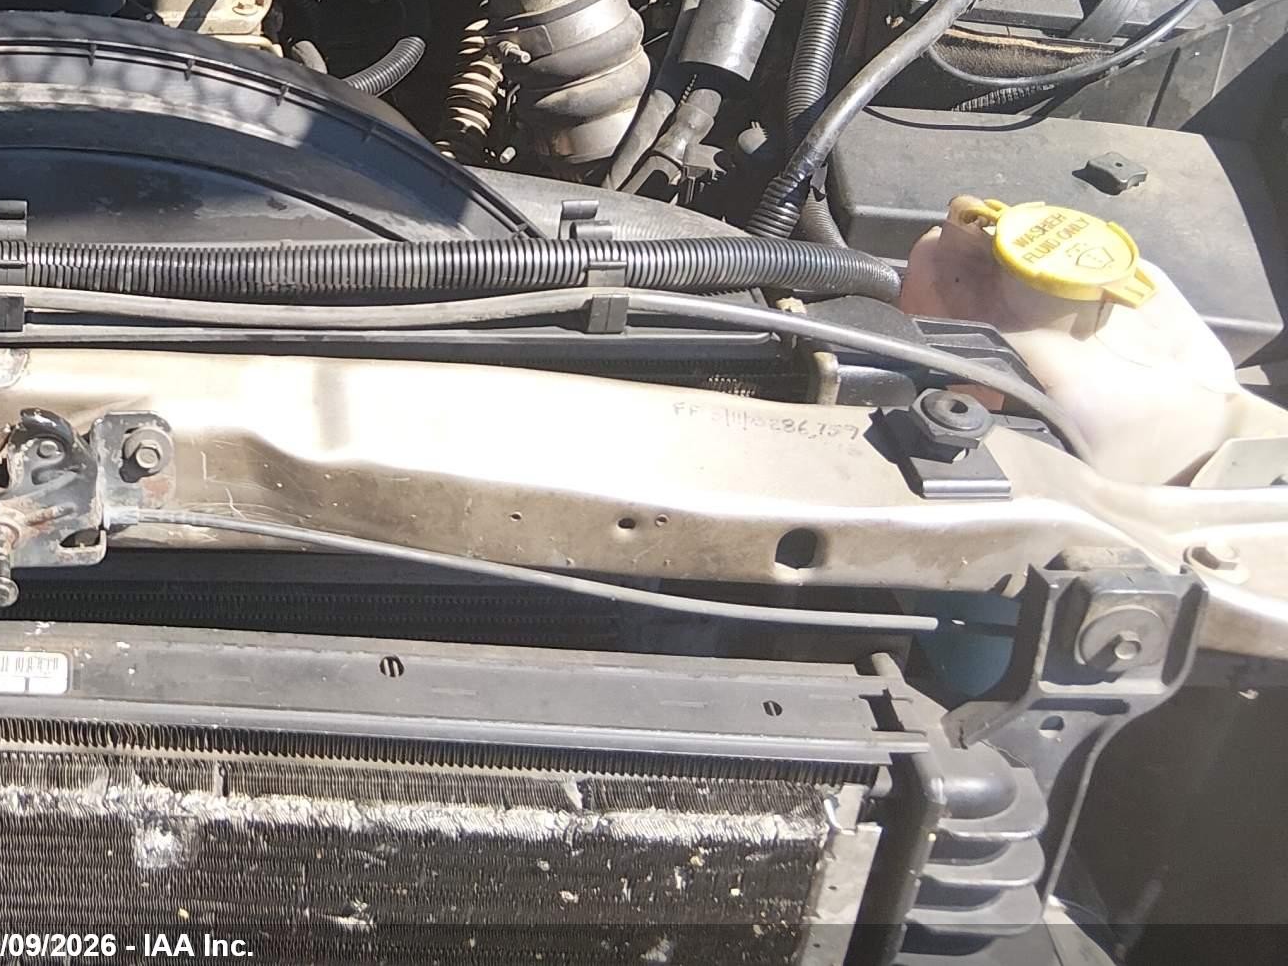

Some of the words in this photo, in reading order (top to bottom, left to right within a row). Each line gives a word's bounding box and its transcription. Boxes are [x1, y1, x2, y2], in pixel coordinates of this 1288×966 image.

[1013, 213, 1066, 248] WASHER
[1022, 238, 1061, 264] FLUID
[1056, 216, 1091, 241] ONLY
